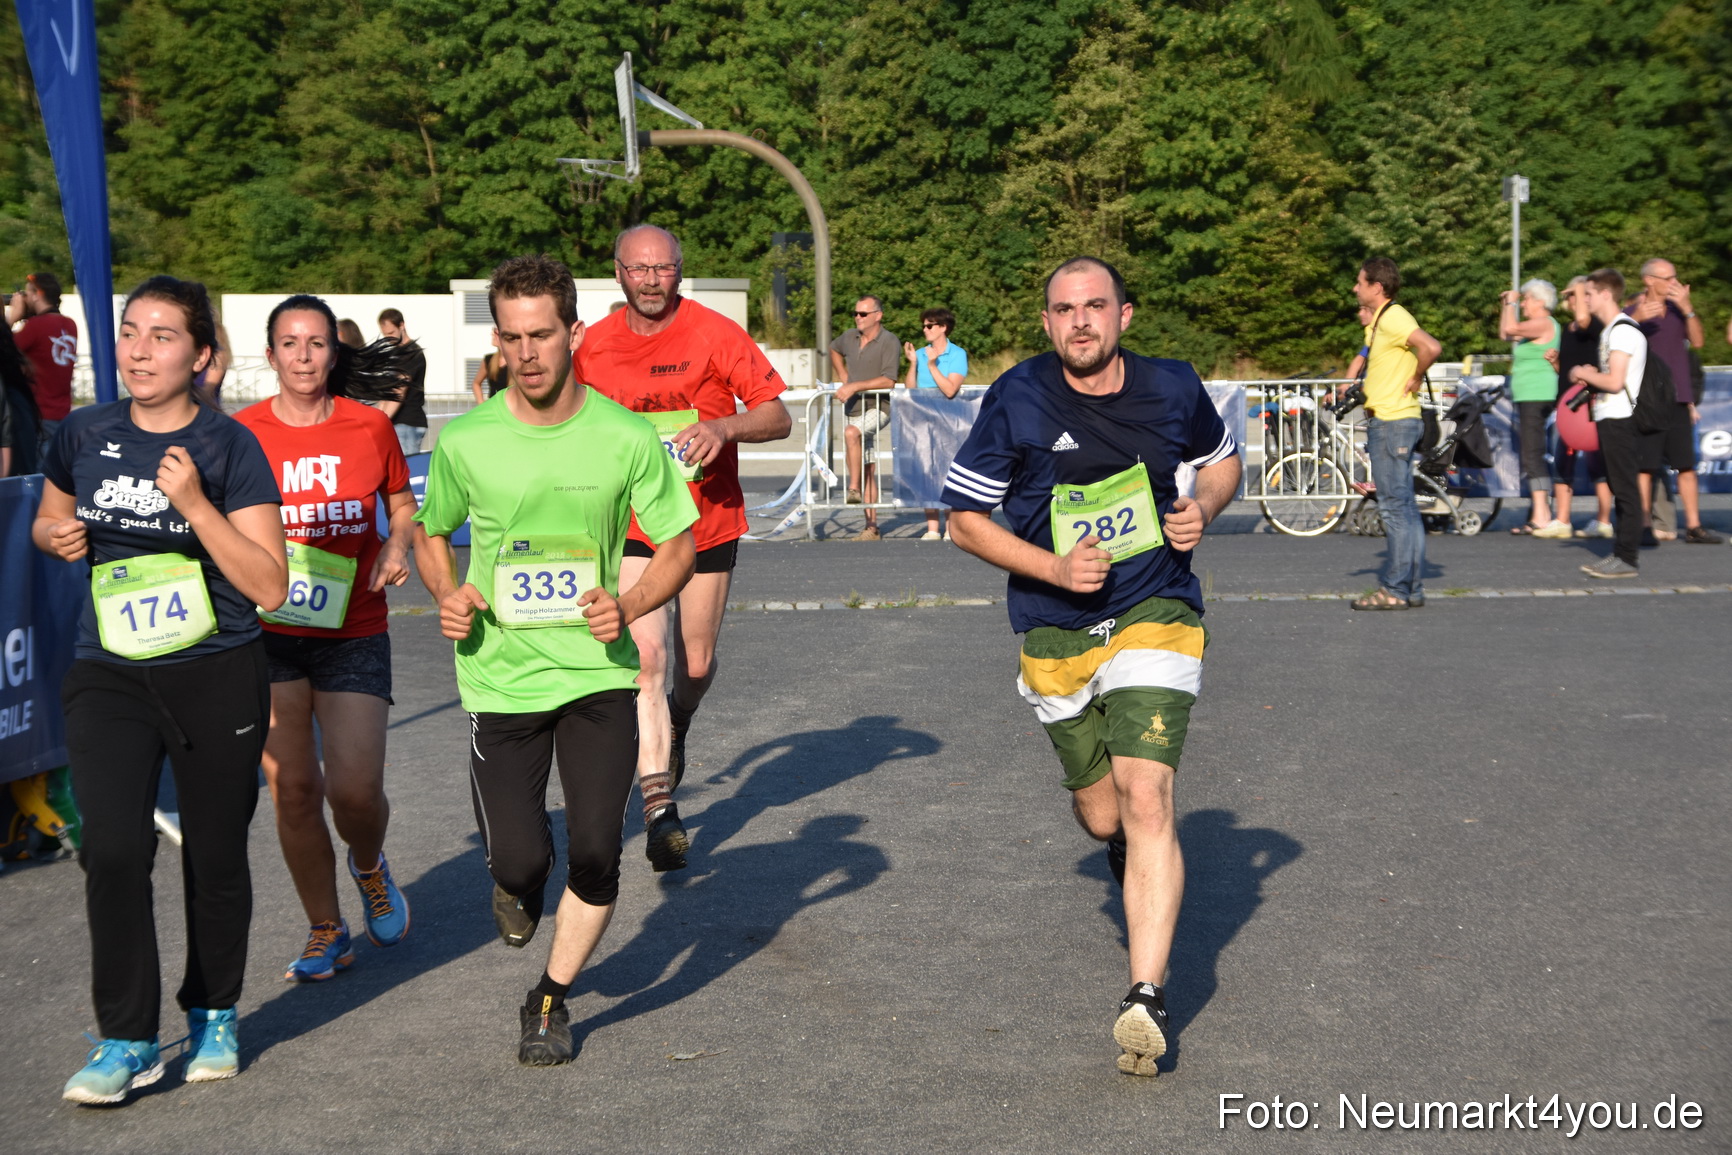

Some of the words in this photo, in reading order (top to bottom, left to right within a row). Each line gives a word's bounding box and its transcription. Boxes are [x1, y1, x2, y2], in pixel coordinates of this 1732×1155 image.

[650, 364, 677, 374] swn
[1052, 442, 1079, 451] adidas
[282, 454, 341, 497] MRT
[95, 480, 169, 516] Burgis
[120, 517, 162, 530] guad
[169, 521, 190, 533] is!
[329, 521, 369, 536] Team
[1072, 507, 1138, 544] 282
[506, 548, 544, 557] firmenlauf
[512, 570, 577, 602] 333
[120, 591, 188, 632] 174
[137, 634, 165, 645] Theresa
[165, 631, 181, 639] Betz
